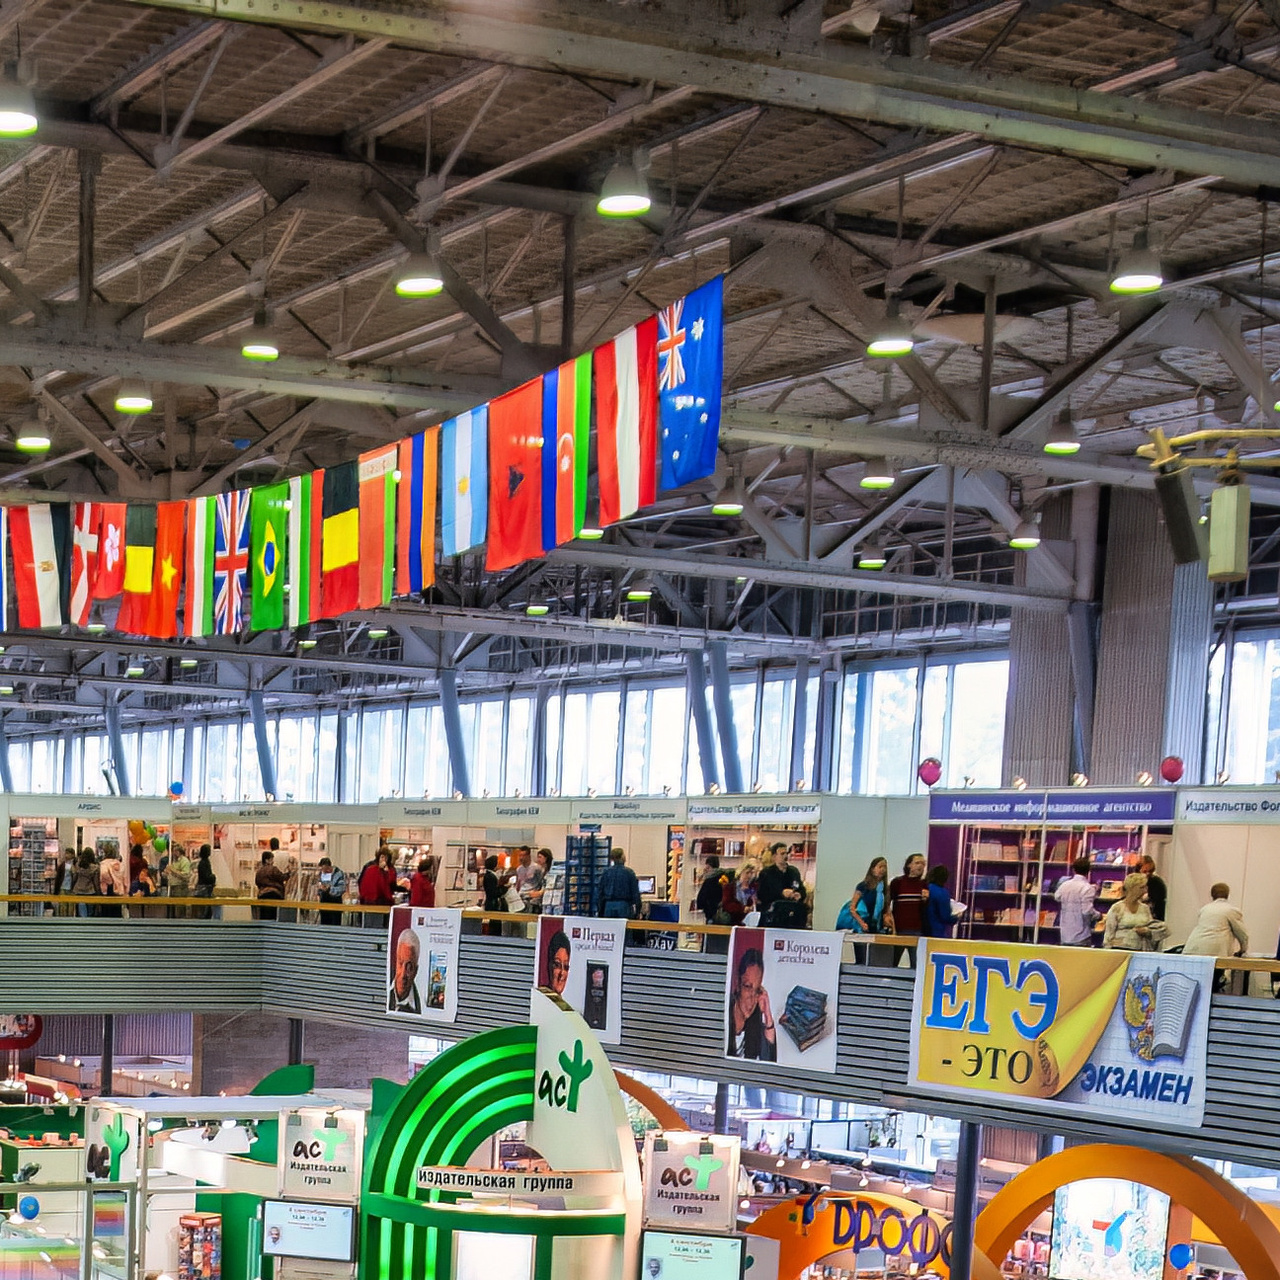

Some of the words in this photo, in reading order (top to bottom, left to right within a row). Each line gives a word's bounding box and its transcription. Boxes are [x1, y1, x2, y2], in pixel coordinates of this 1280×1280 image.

[1103, 802, 1152, 813] агентство
[1185, 800, 1258, 813] Издательство
[925, 952, 1060, 1041] ЕГЭ
[961, 1044, 1034, 1085] ЭТО
[1080, 1063, 1194, 1106] ЭКЗАМЕН
[290, 1161, 348, 1173] Издательская
[304, 1175, 332, 1186] группа
[523, 1176, 574, 1192] группа
[657, 1189, 721, 1202] Издательская
[672, 1204, 704, 1215] группа
